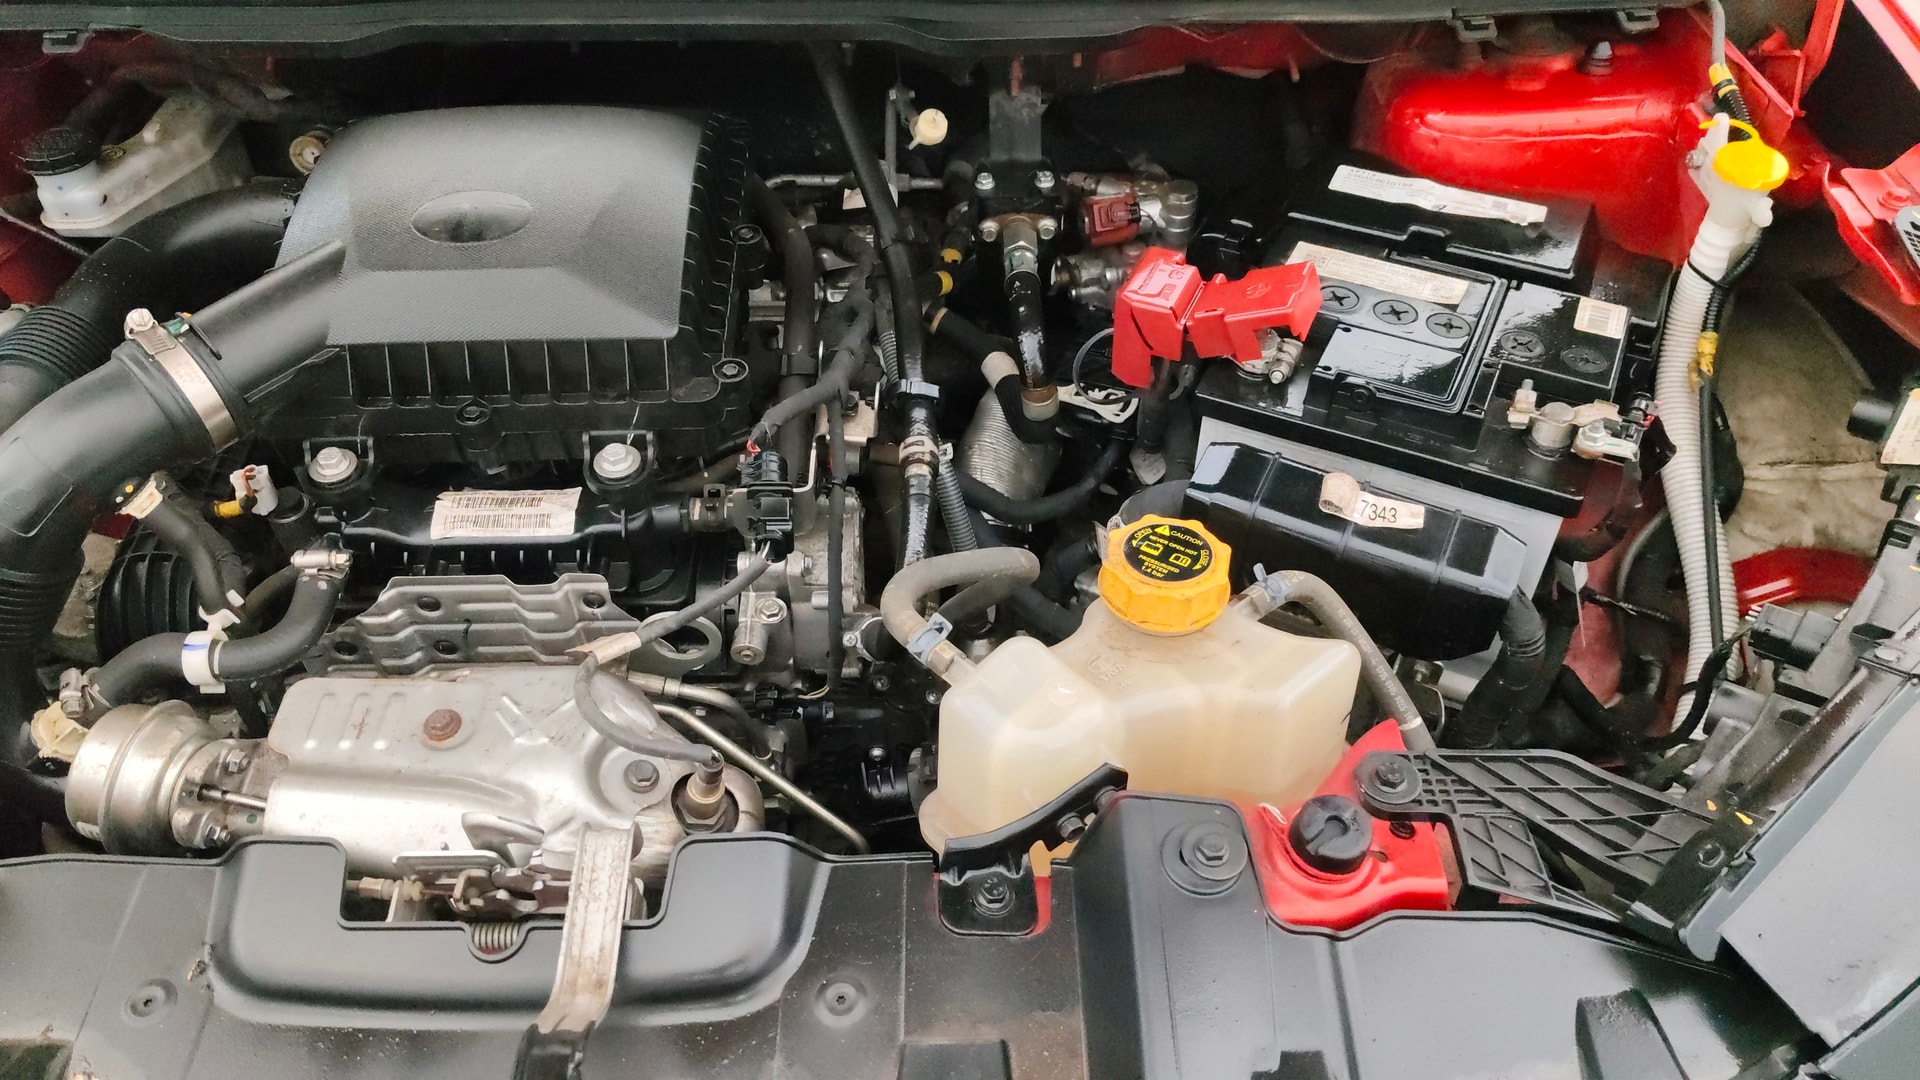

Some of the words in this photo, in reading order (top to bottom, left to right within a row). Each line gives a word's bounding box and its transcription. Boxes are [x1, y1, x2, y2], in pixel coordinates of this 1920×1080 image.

[1360, 499, 1398, 523] 7343
[1134, 527, 1150, 538] OPEN
[1170, 530, 1203, 546] CAUTION
[1148, 534, 1169, 545] NEVER
[1169, 541, 1185, 552] OPEN
[1185, 548, 1198, 556] HOT
[1143, 561, 1169, 574] SYSTEM
[1152, 569, 1165, 578] bar
